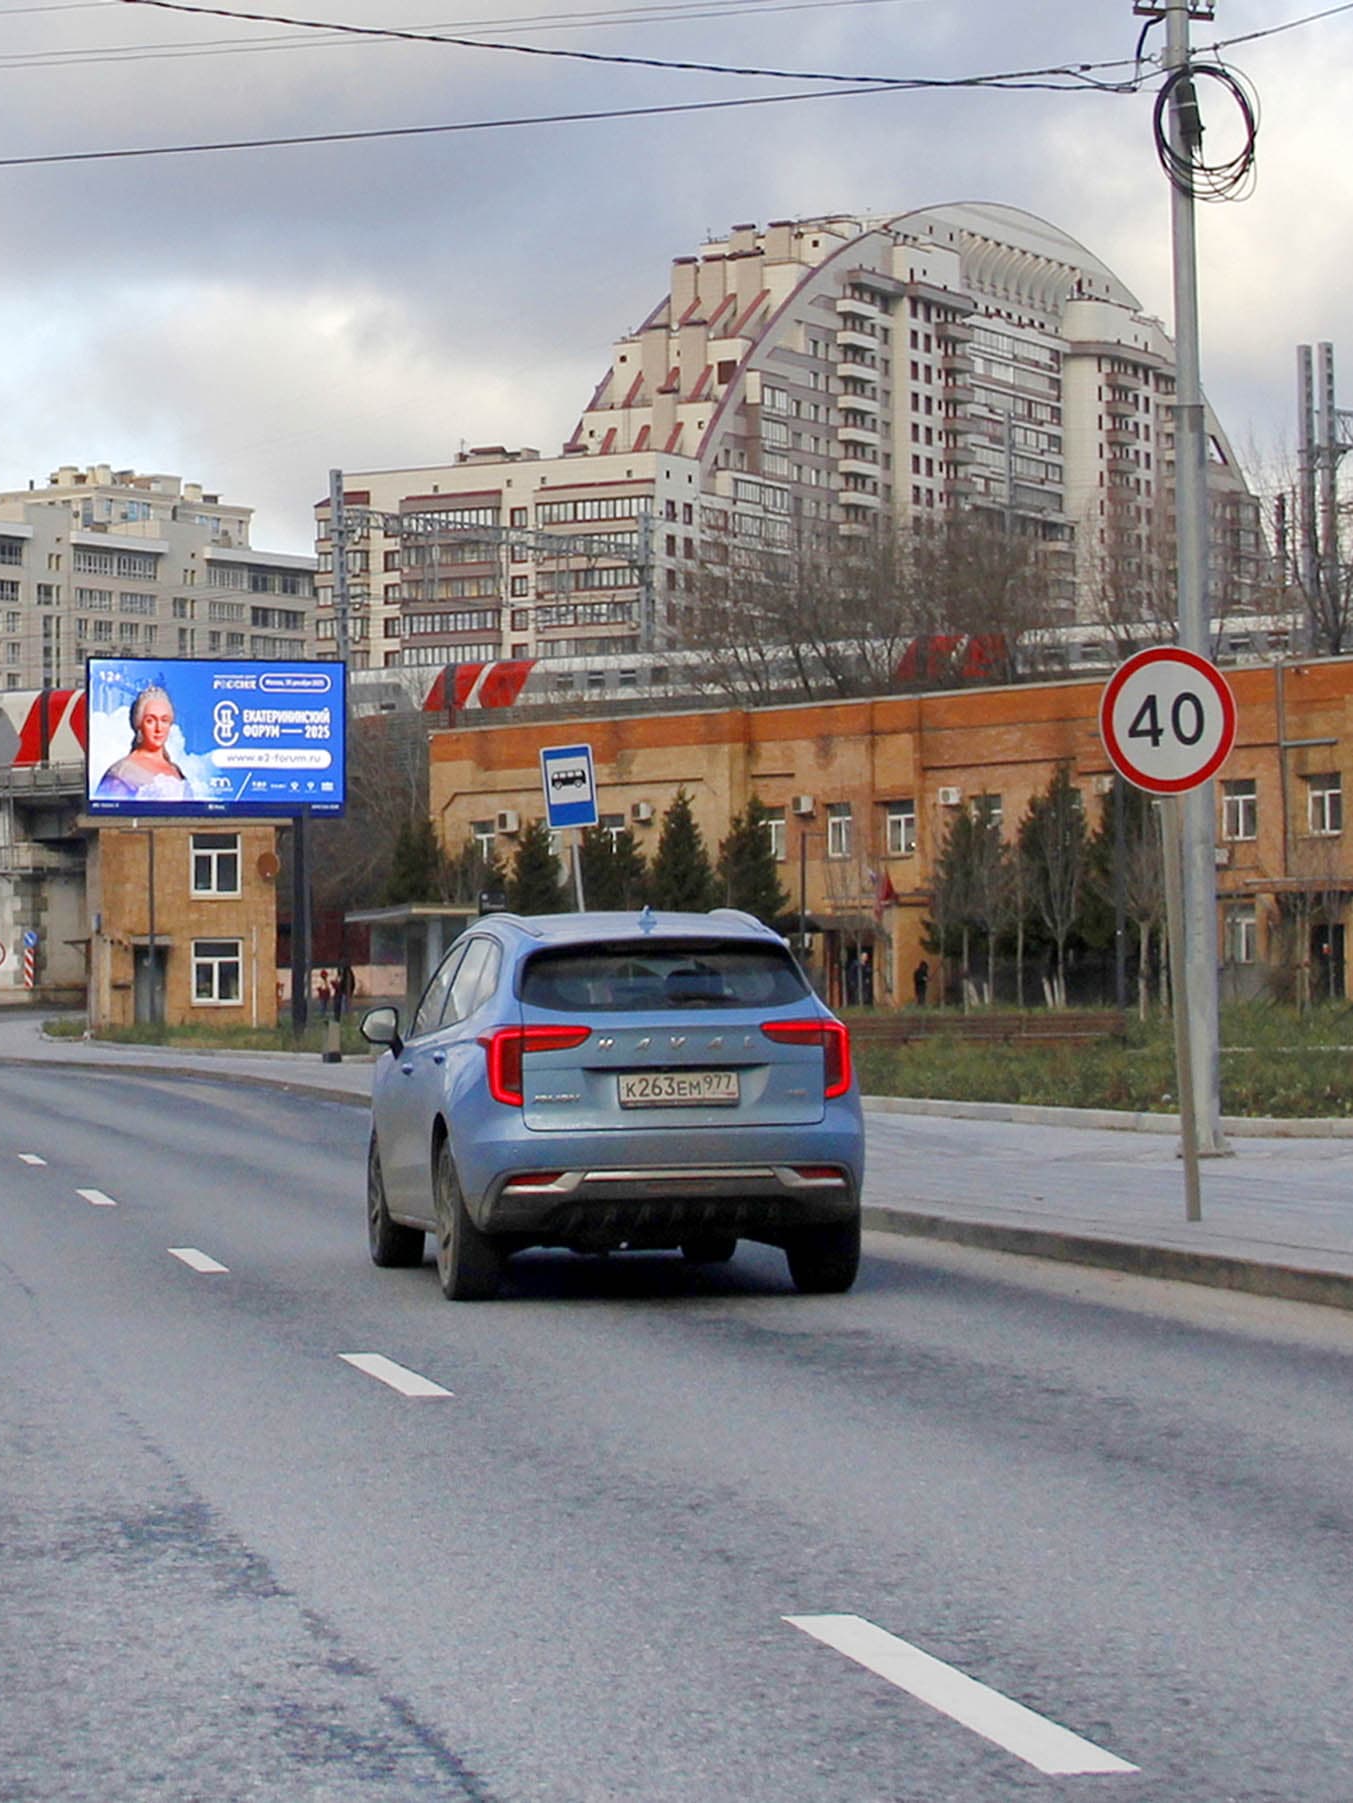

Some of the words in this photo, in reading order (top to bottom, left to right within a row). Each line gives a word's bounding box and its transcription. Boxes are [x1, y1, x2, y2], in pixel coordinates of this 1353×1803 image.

[243, 707, 330, 724] ЕКАТЕРИНИНСКИЙ
[1128, 691, 1205, 747] 40
[243, 725, 280, 738] ФОРУМ
[304, 725, 330, 738] 2025
[227, 753, 321, 763] www.e2-forum.ru
